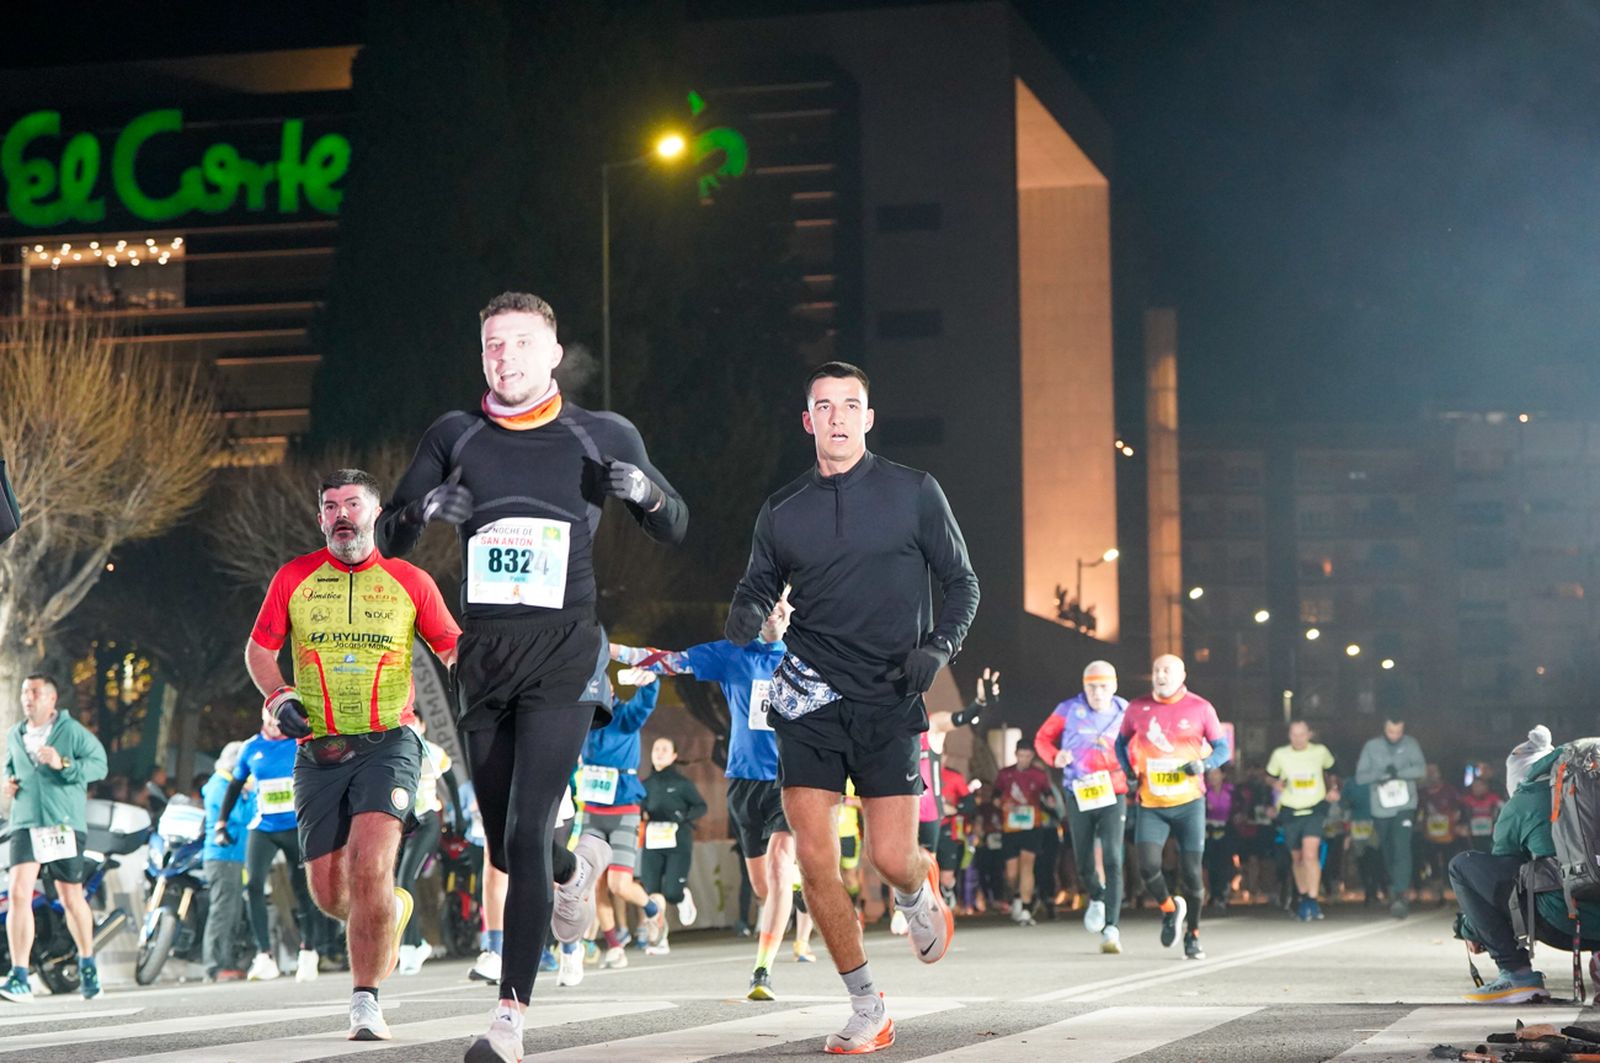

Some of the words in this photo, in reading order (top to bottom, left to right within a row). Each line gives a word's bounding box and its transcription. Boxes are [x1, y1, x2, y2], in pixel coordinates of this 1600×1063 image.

[1, 109, 106, 227] El
[112, 108, 352, 222] Corte
[492, 526, 520, 535] NOCHE
[522, 527, 533, 536] DE
[480, 536, 499, 545] SAN
[333, 632, 394, 644] HYUNDAI
